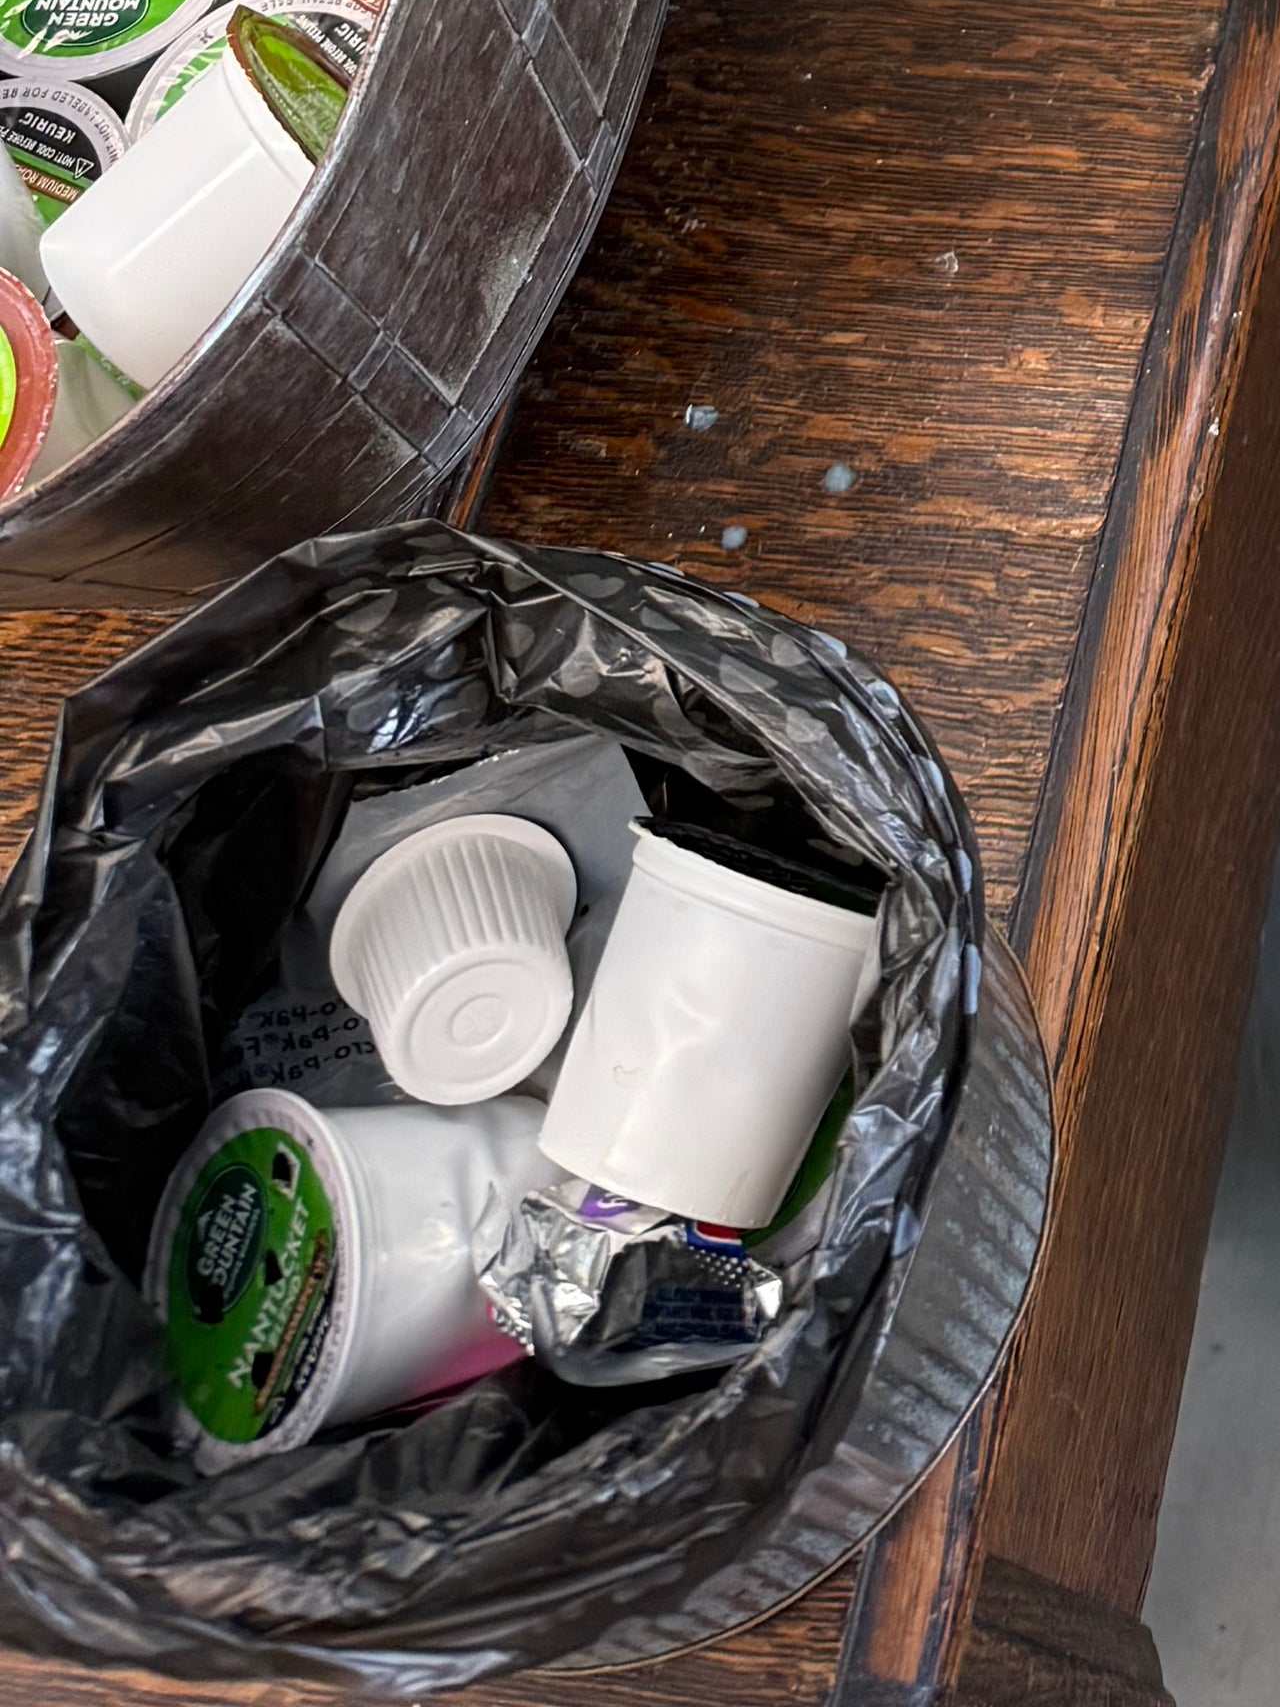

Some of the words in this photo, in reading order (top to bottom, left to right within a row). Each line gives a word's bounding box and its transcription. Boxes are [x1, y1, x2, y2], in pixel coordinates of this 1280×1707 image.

[48, 12, 119, 27] GREEN
[23, 87, 49, 97] FOR
[52, 90, 100, 122] LABELED
[18, 112, 76, 144] KEURIG
[37, 175, 79, 200] MEDIUM
[197, 1194, 236, 1277] GREEN
[212, 1182, 257, 1286] OUNTAIN
